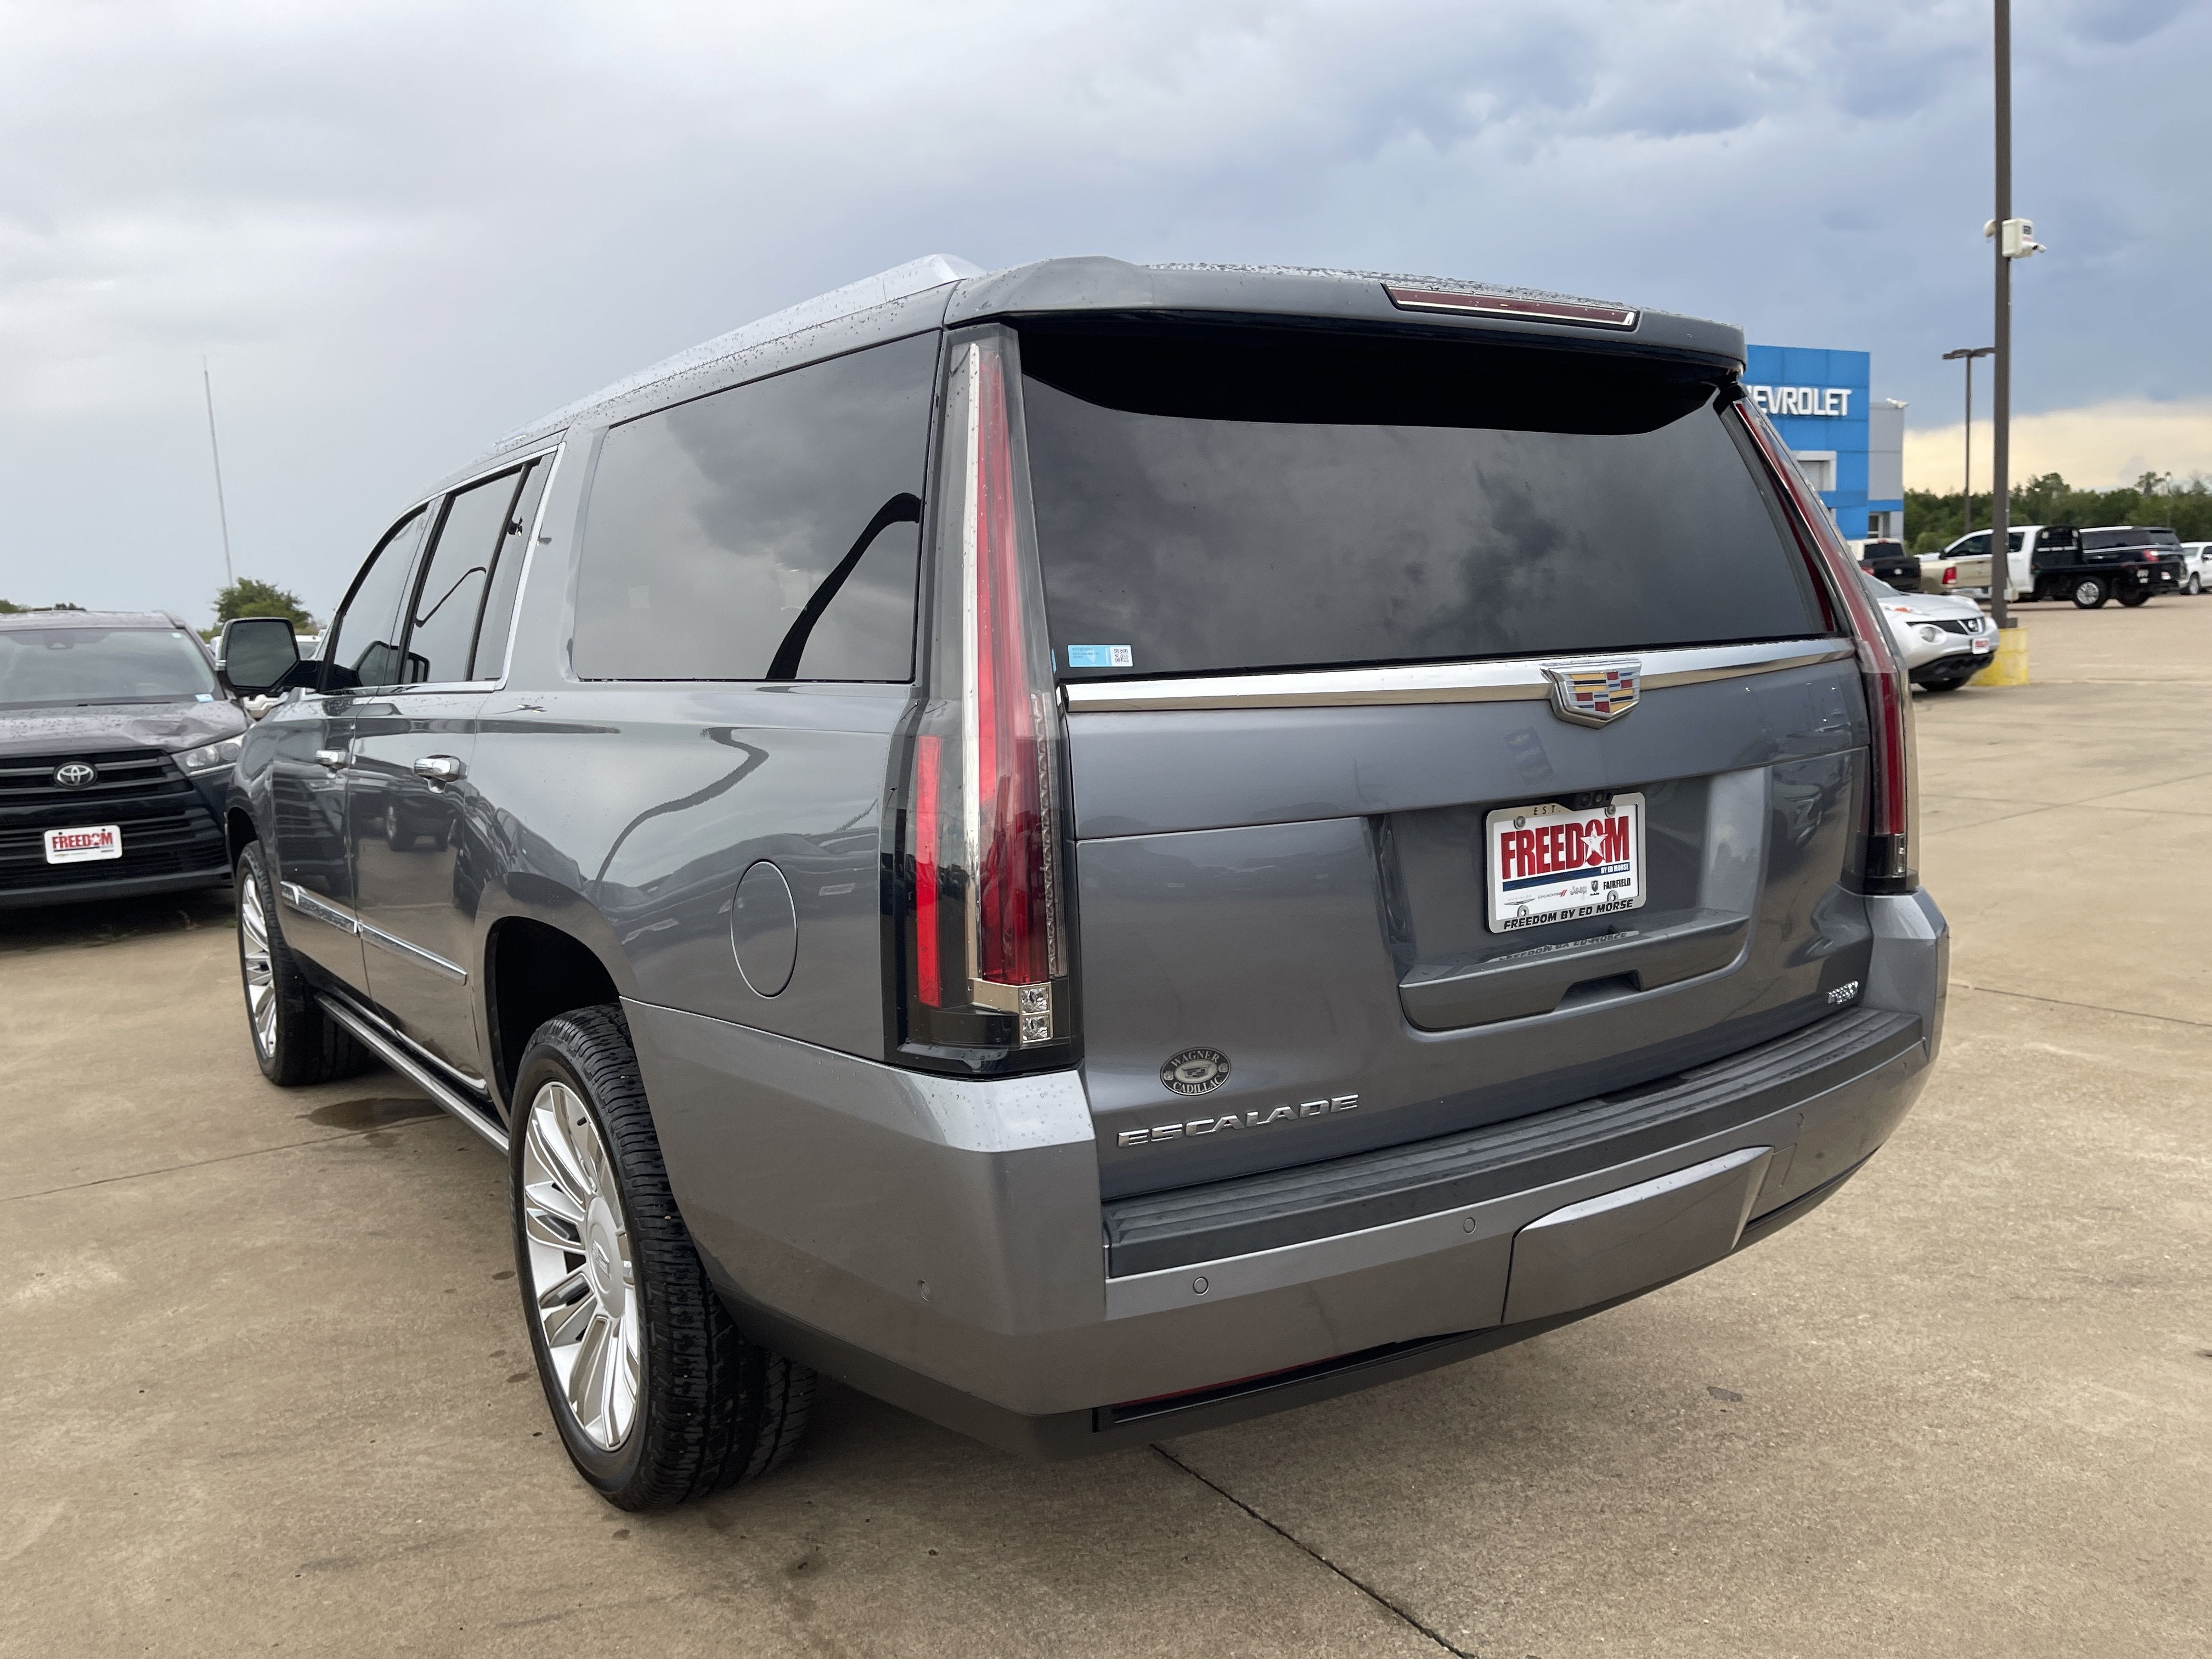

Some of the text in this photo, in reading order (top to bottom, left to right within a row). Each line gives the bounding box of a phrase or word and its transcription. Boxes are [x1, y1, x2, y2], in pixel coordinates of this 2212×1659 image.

[1746, 385, 1852, 416] EVROLET
[52, 832, 113, 849] FREEDOM
[1500, 815, 1630, 880] FREEDOM
[1603, 878, 1631, 890] FAIRFIELD
[1504, 899, 1634, 929] FREEDOM BY ED MORSE
[1171, 1050, 1220, 1067] WAGNER
[1173, 1075, 1223, 1093] CADILLAC
[1118, 1094, 1359, 1148] ESCALADE
